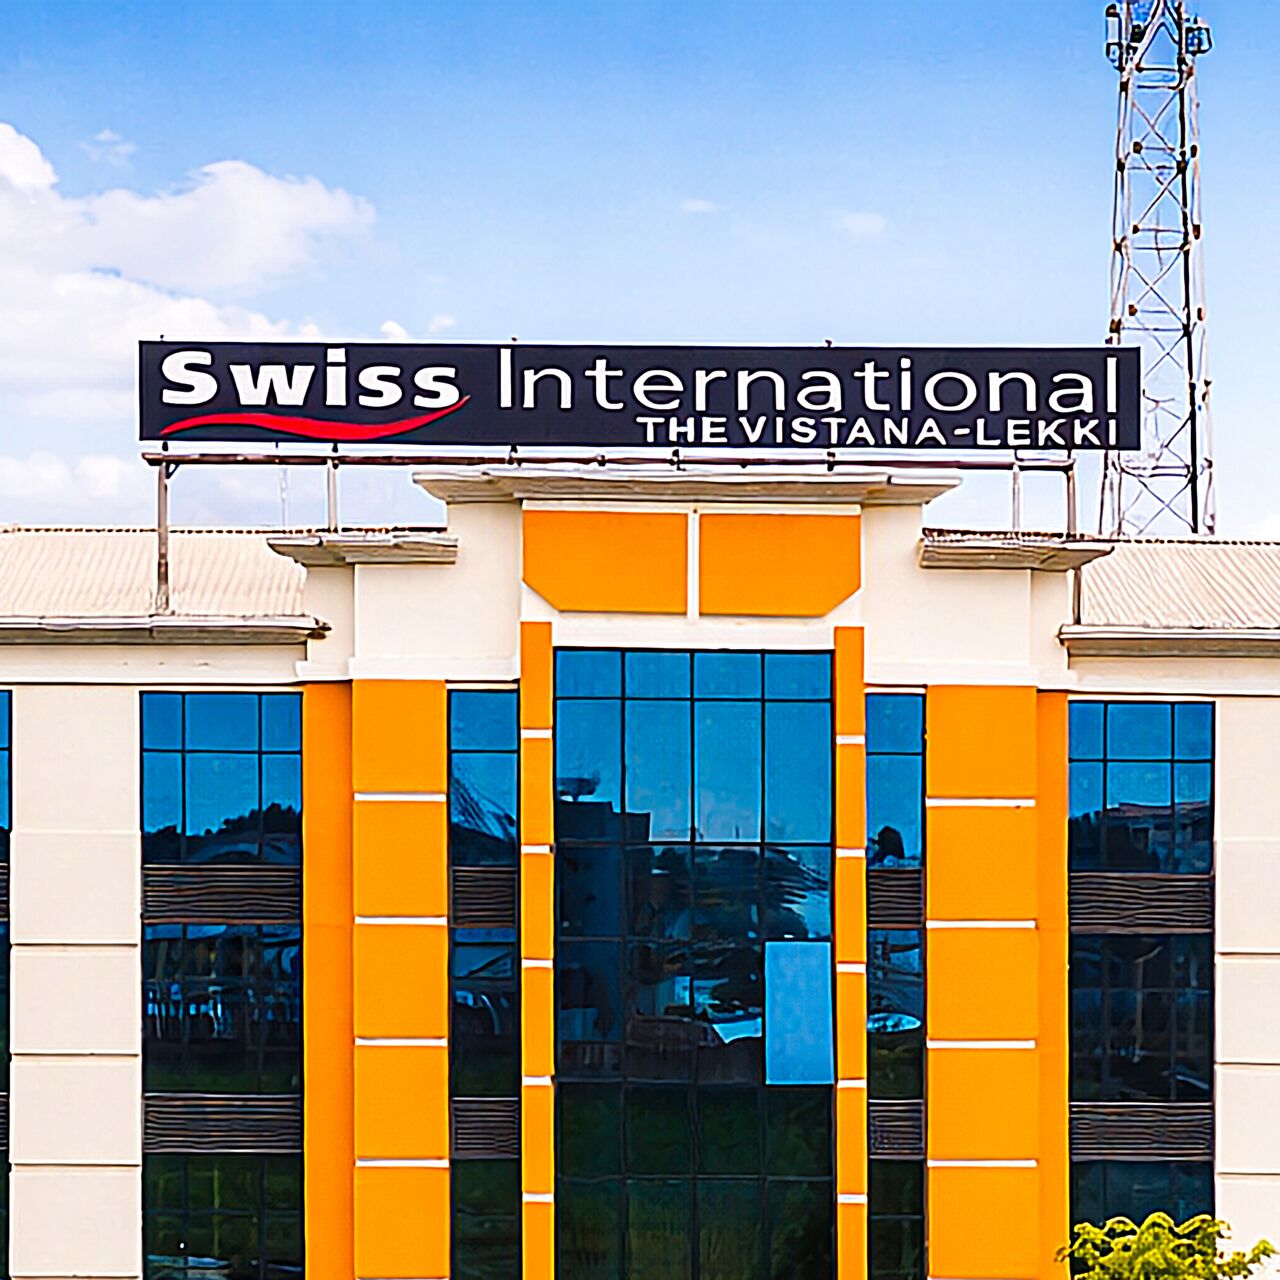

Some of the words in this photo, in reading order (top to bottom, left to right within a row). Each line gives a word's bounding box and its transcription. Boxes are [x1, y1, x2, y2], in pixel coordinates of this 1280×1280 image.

[161, 347, 461, 409] Swiss
[499, 347, 1118, 414] International
[635, 416, 728, 443] THE
[738, 416, 1117, 446] VISTANA-LEKKI
